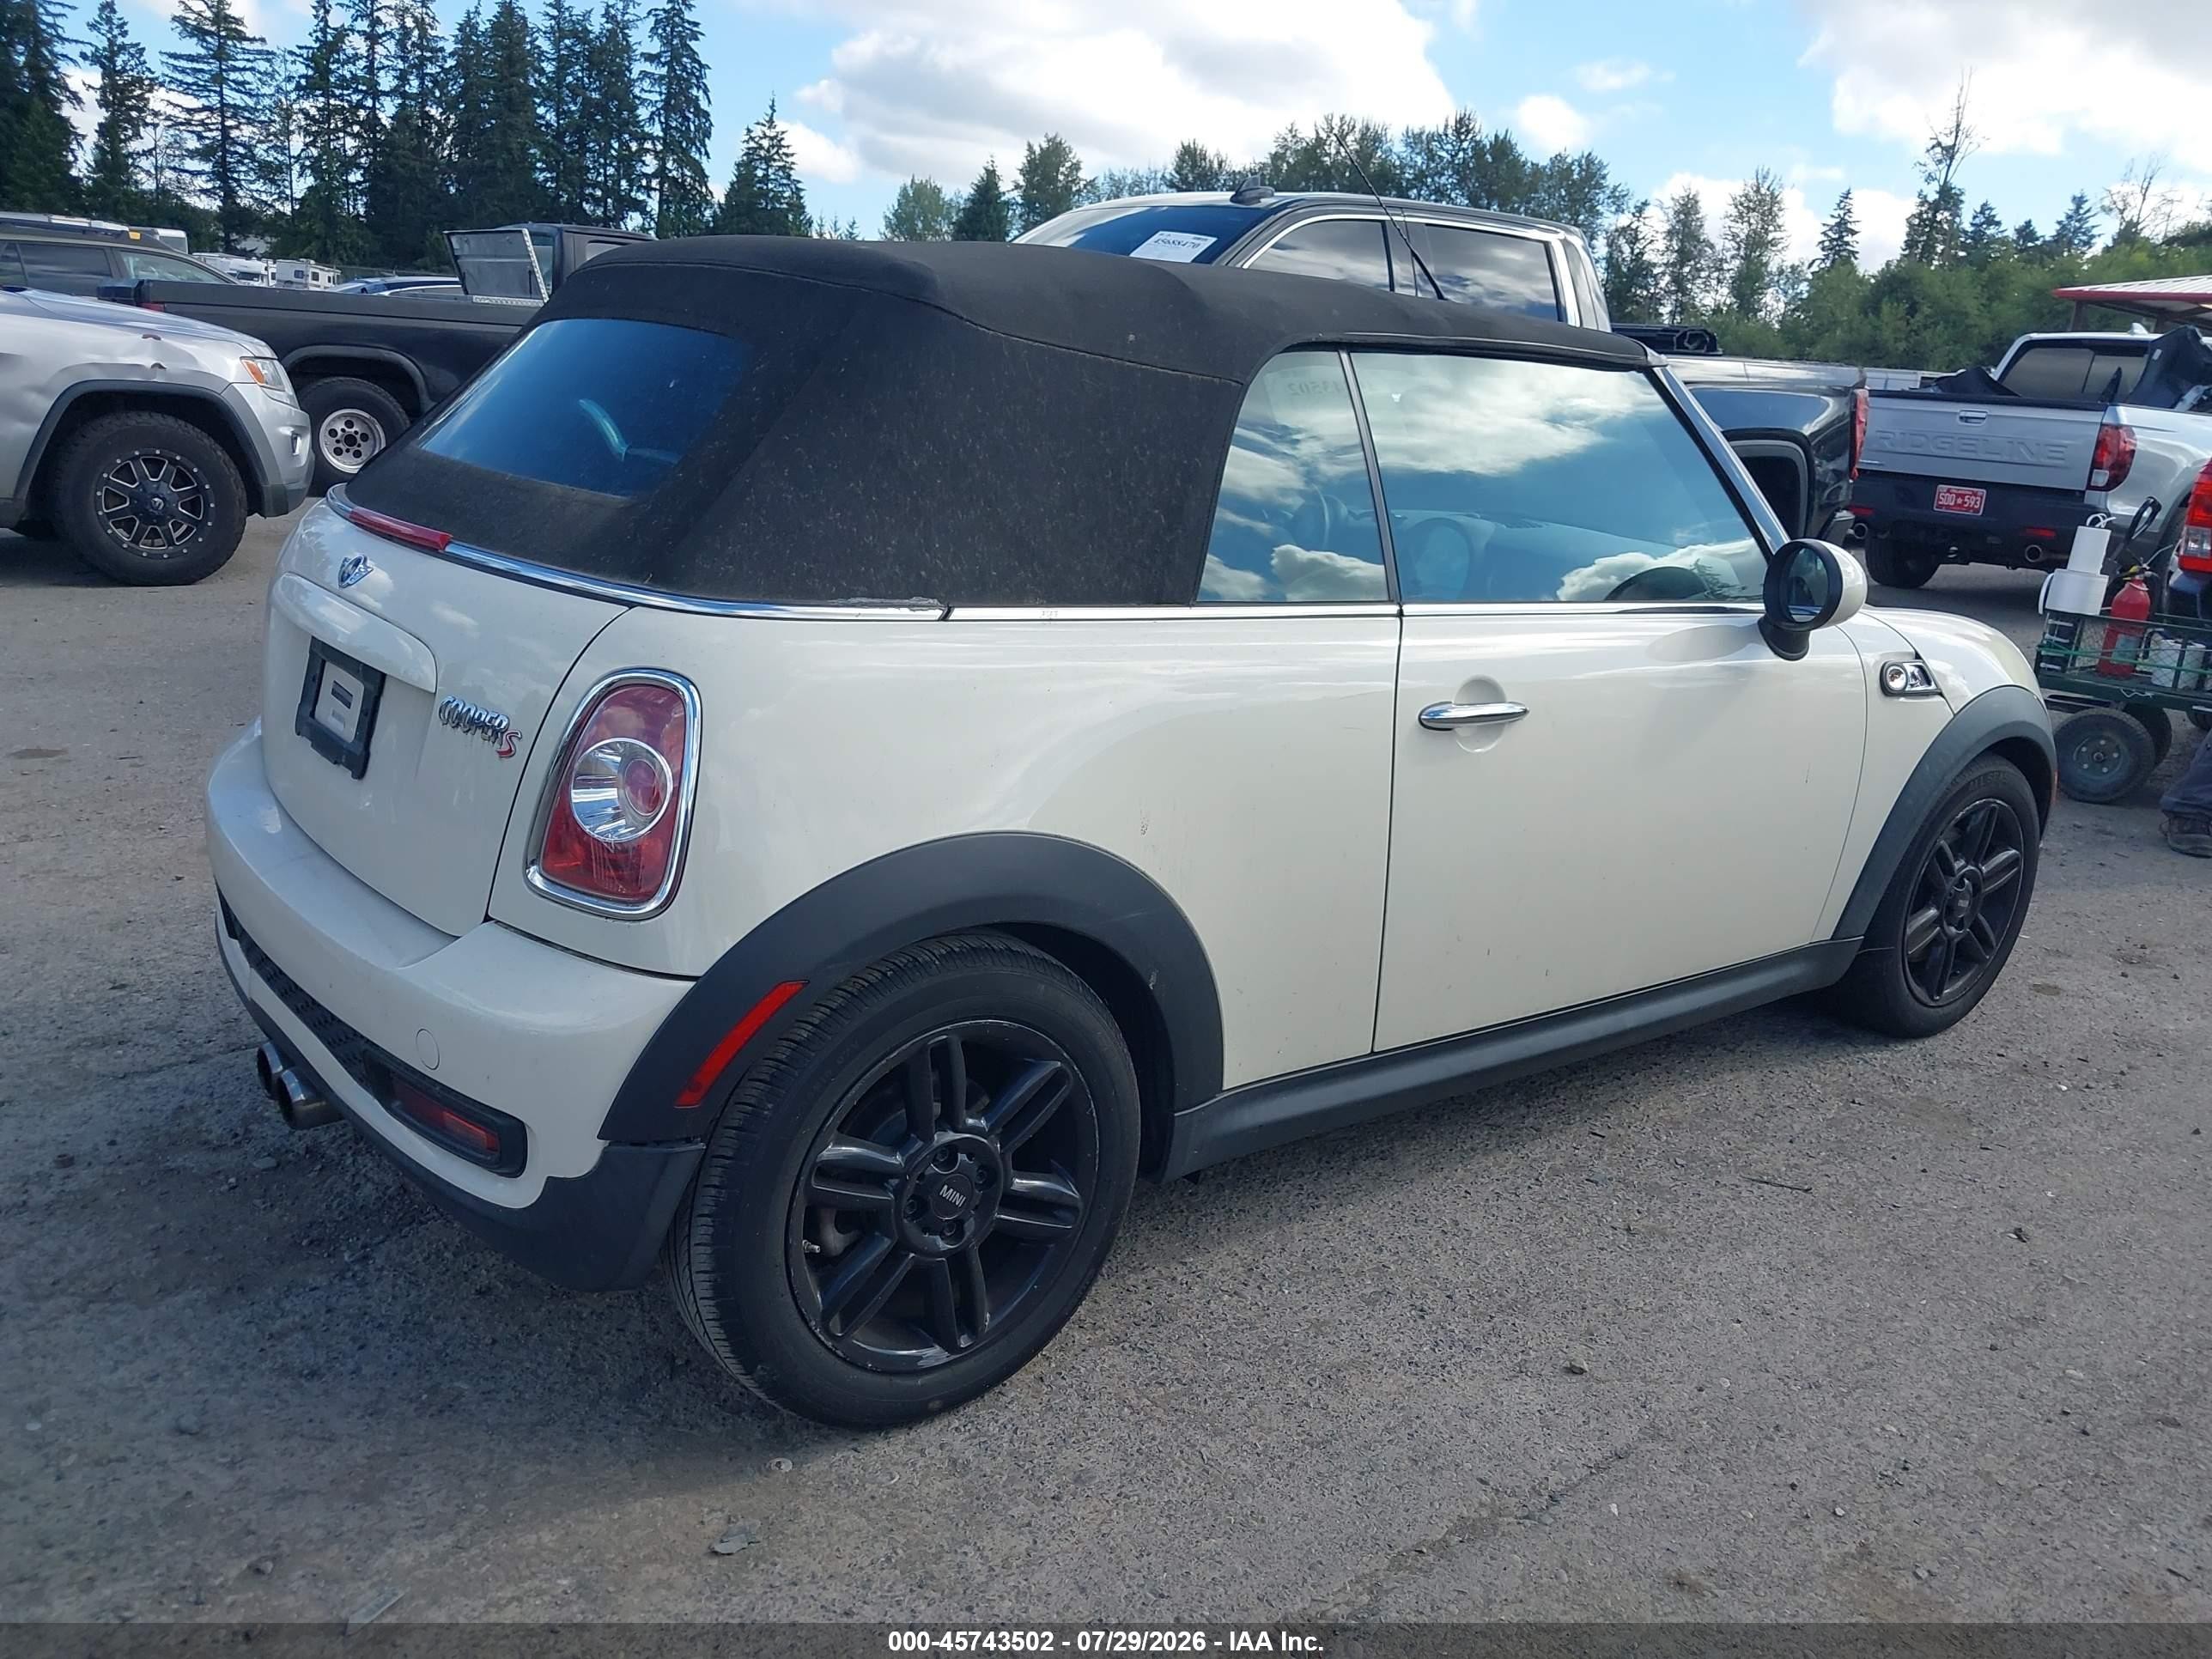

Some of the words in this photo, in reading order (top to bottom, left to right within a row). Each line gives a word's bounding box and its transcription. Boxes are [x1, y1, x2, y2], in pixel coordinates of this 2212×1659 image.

[1875, 429, 2070, 465] RIDGELINE
[1963, 495, 1982, 509] 593
[439, 696, 510, 749] COOPER
[495, 729, 522, 759] S
[939, 1184, 966, 1208] MINI
